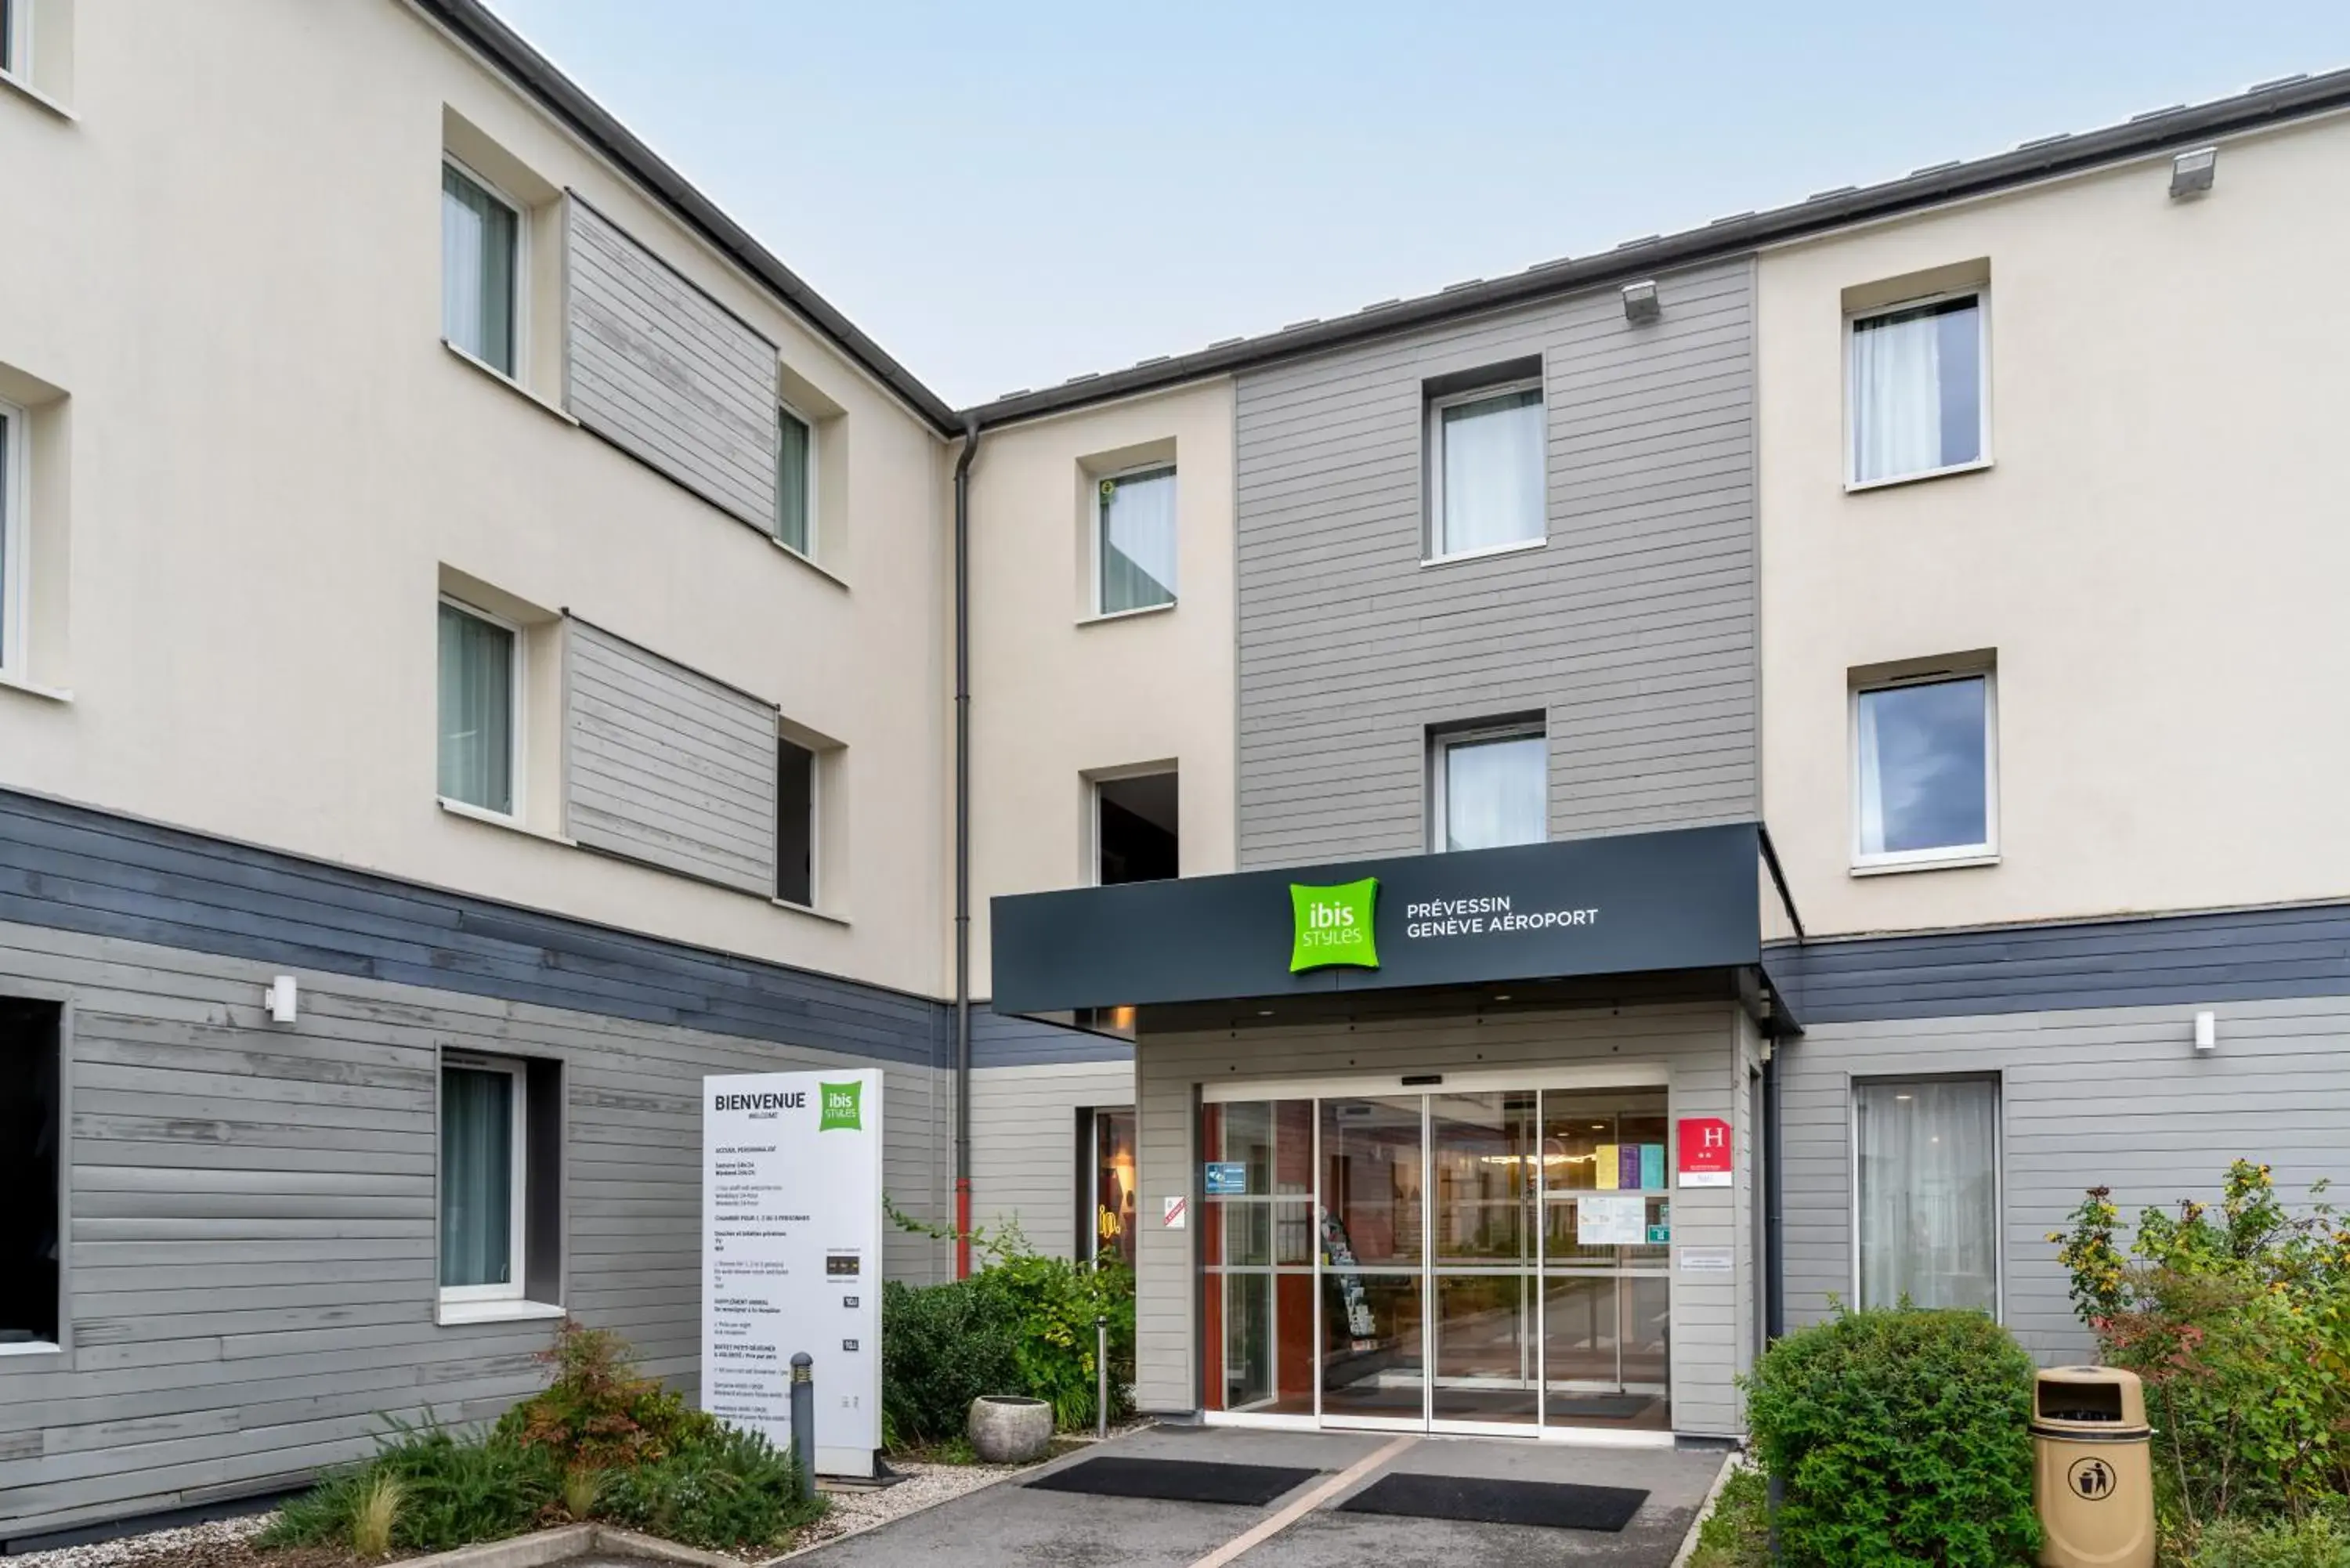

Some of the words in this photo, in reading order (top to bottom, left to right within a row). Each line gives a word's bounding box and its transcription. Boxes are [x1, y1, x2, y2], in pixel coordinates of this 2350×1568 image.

[1310, 901, 1354, 928] ibis
[1407, 896, 1511, 919] PRÉVESSIN
[1407, 918, 1483, 938] GENÈVE
[1489, 909, 1599, 932] AÉROPORT
[714, 1093, 806, 1111] BIENVENUE
[829, 1093, 853, 1108] ibis
[1704, 1127, 1724, 1148] H
